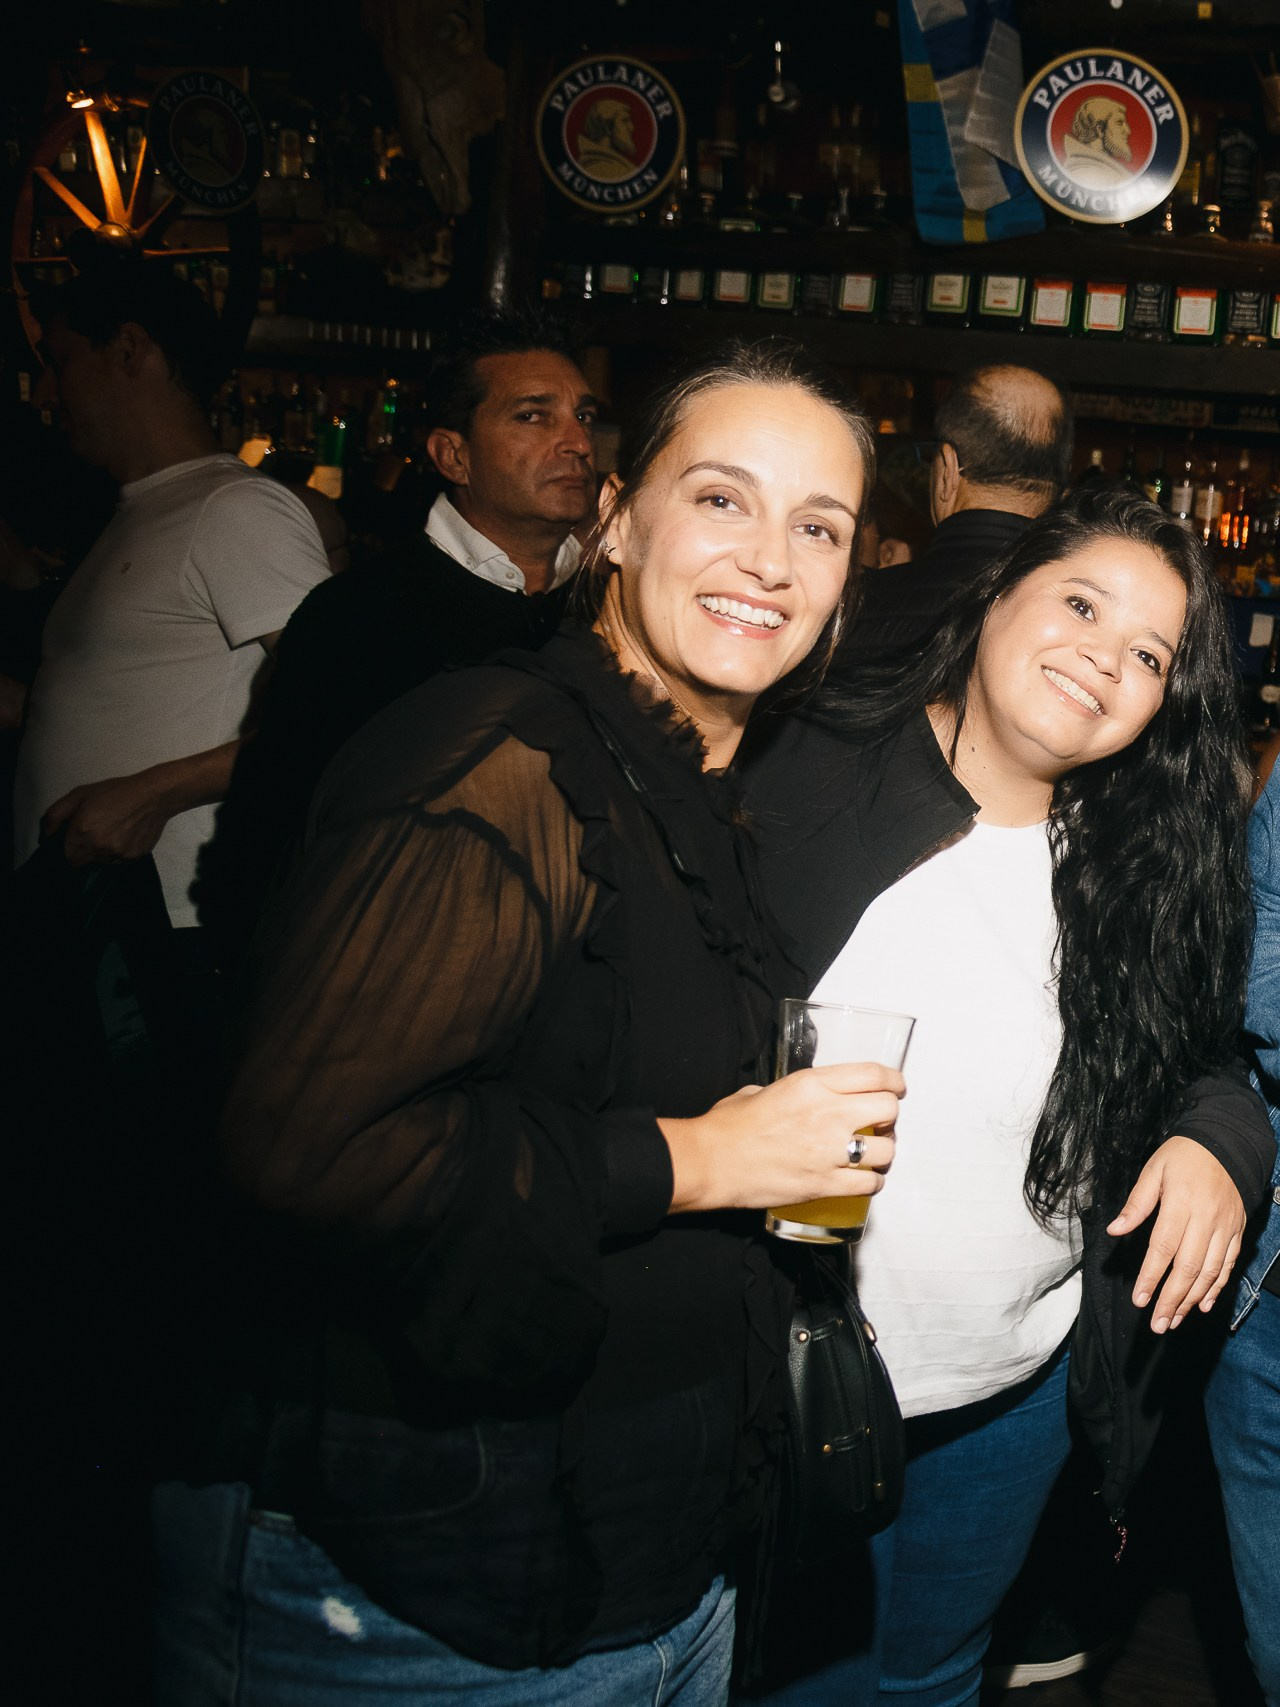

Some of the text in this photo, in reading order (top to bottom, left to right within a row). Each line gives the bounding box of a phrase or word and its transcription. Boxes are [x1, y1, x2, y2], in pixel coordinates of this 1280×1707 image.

[160, 76, 258, 136] PAULANER
[550, 63, 673, 121] PAULANER
[1033, 58, 1175, 125] PAULANER
